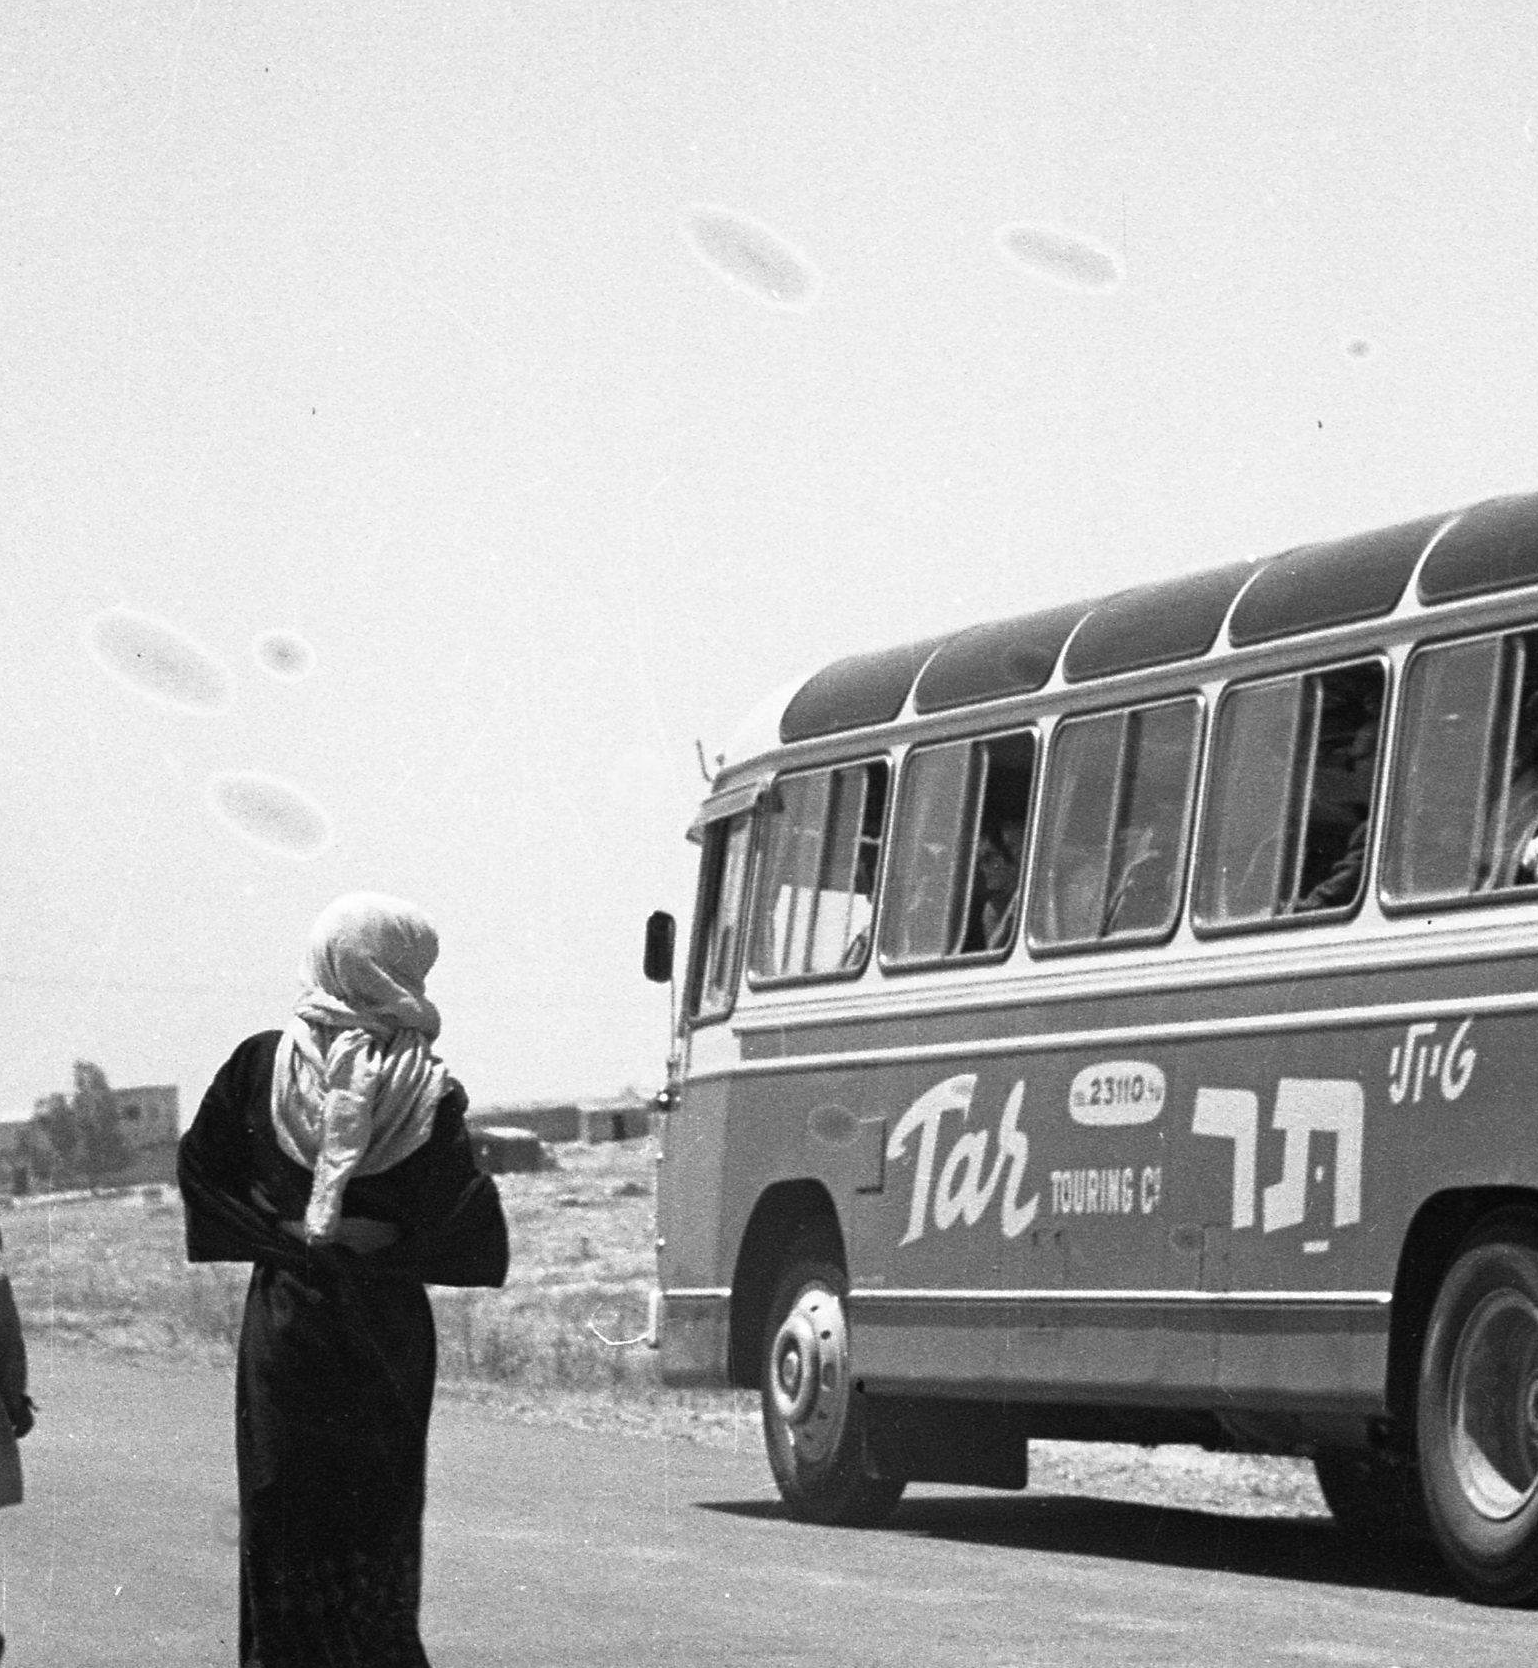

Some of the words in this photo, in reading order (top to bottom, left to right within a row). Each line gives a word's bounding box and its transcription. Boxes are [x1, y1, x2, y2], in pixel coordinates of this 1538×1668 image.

[1089, 1074, 1145, 1107] 23110
[886, 1073, 1040, 1247] Tar
[1051, 1167, 1133, 1214] TOURING
